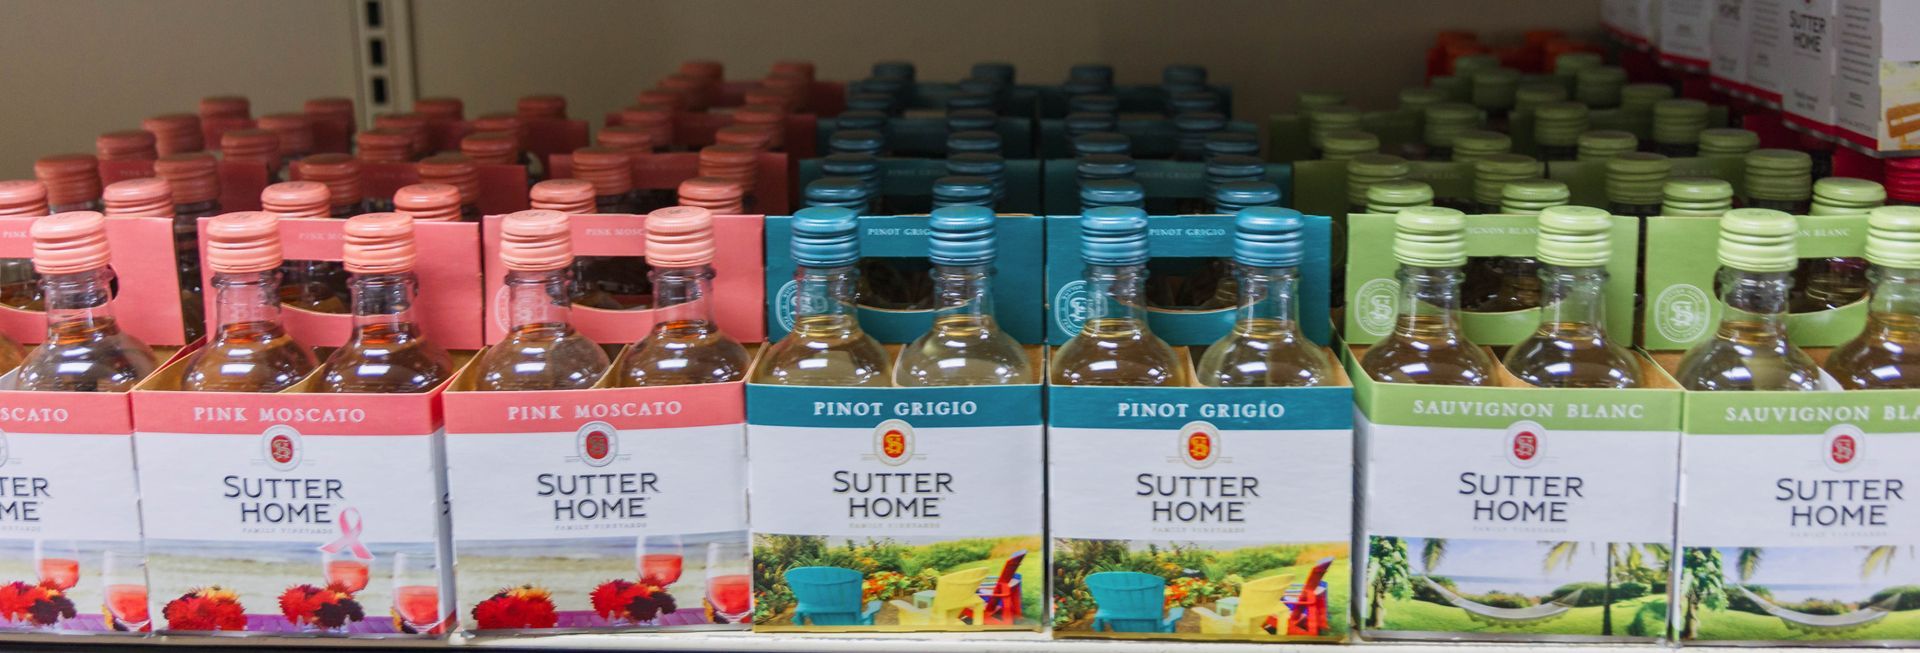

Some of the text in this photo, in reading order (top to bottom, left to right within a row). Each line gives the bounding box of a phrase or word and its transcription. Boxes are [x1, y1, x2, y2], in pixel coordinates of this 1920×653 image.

[1794, 34, 1822, 52] HOME
[585, 228, 611, 237] PINK
[867, 228, 900, 236] PINOT
[1148, 228, 1226, 236] PINOT GRIGIO
[0, 407, 69, 422] SCATO
[193, 407, 366, 423] PINK MOSCATO
[507, 401, 682, 420] PINK MOSCATO
[813, 401, 978, 416] PINOT GRIGIO
[1117, 402, 1286, 418] PINOT GRIGIO
[1413, 400, 1645, 419] SAUVIGNON BLANC
[1725, 406, 1871, 422] SAUVIGNON
[0, 476, 51, 498] TER
[223, 475, 345, 499] SUTTER
[537, 472, 661, 496] SUTTER
[833, 470, 955, 493] SUTTER
[1136, 473, 1260, 497] SUTTER
[1458, 472, 1584, 498] SUTTER
[1776, 478, 1905, 501] SUTTER
[0, 501, 40, 521] ME
[241, 502, 333, 523] HOME
[554, 498, 648, 520] HOME
[849, 497, 940, 518] HOME
[1152, 501, 1245, 523] HOME
[1473, 500, 1568, 523] HOME
[1790, 504, 1888, 527] HOME
